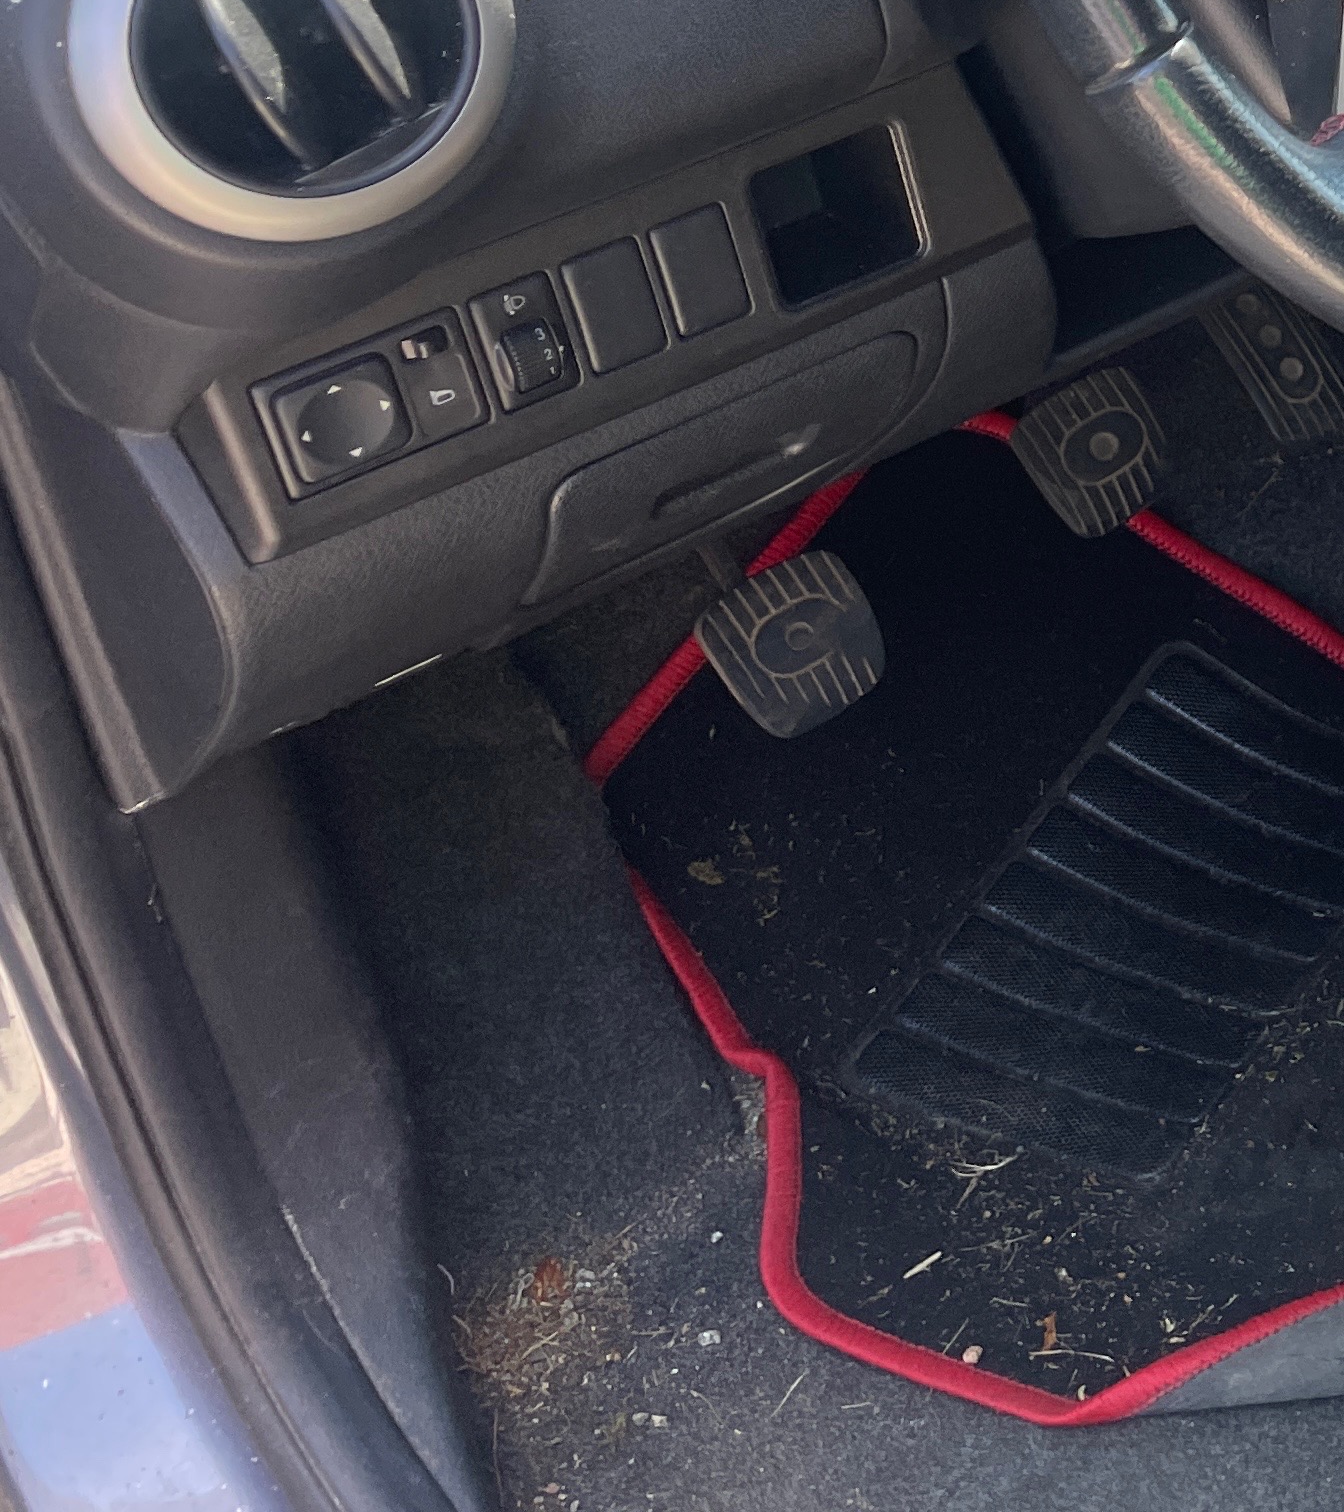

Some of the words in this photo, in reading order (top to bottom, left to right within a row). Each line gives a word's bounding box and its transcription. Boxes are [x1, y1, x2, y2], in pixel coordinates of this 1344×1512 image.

[534, 327, 546, 341] 3
[543, 348, 553, 361] 2
[549, 366, 556, 375] 1
